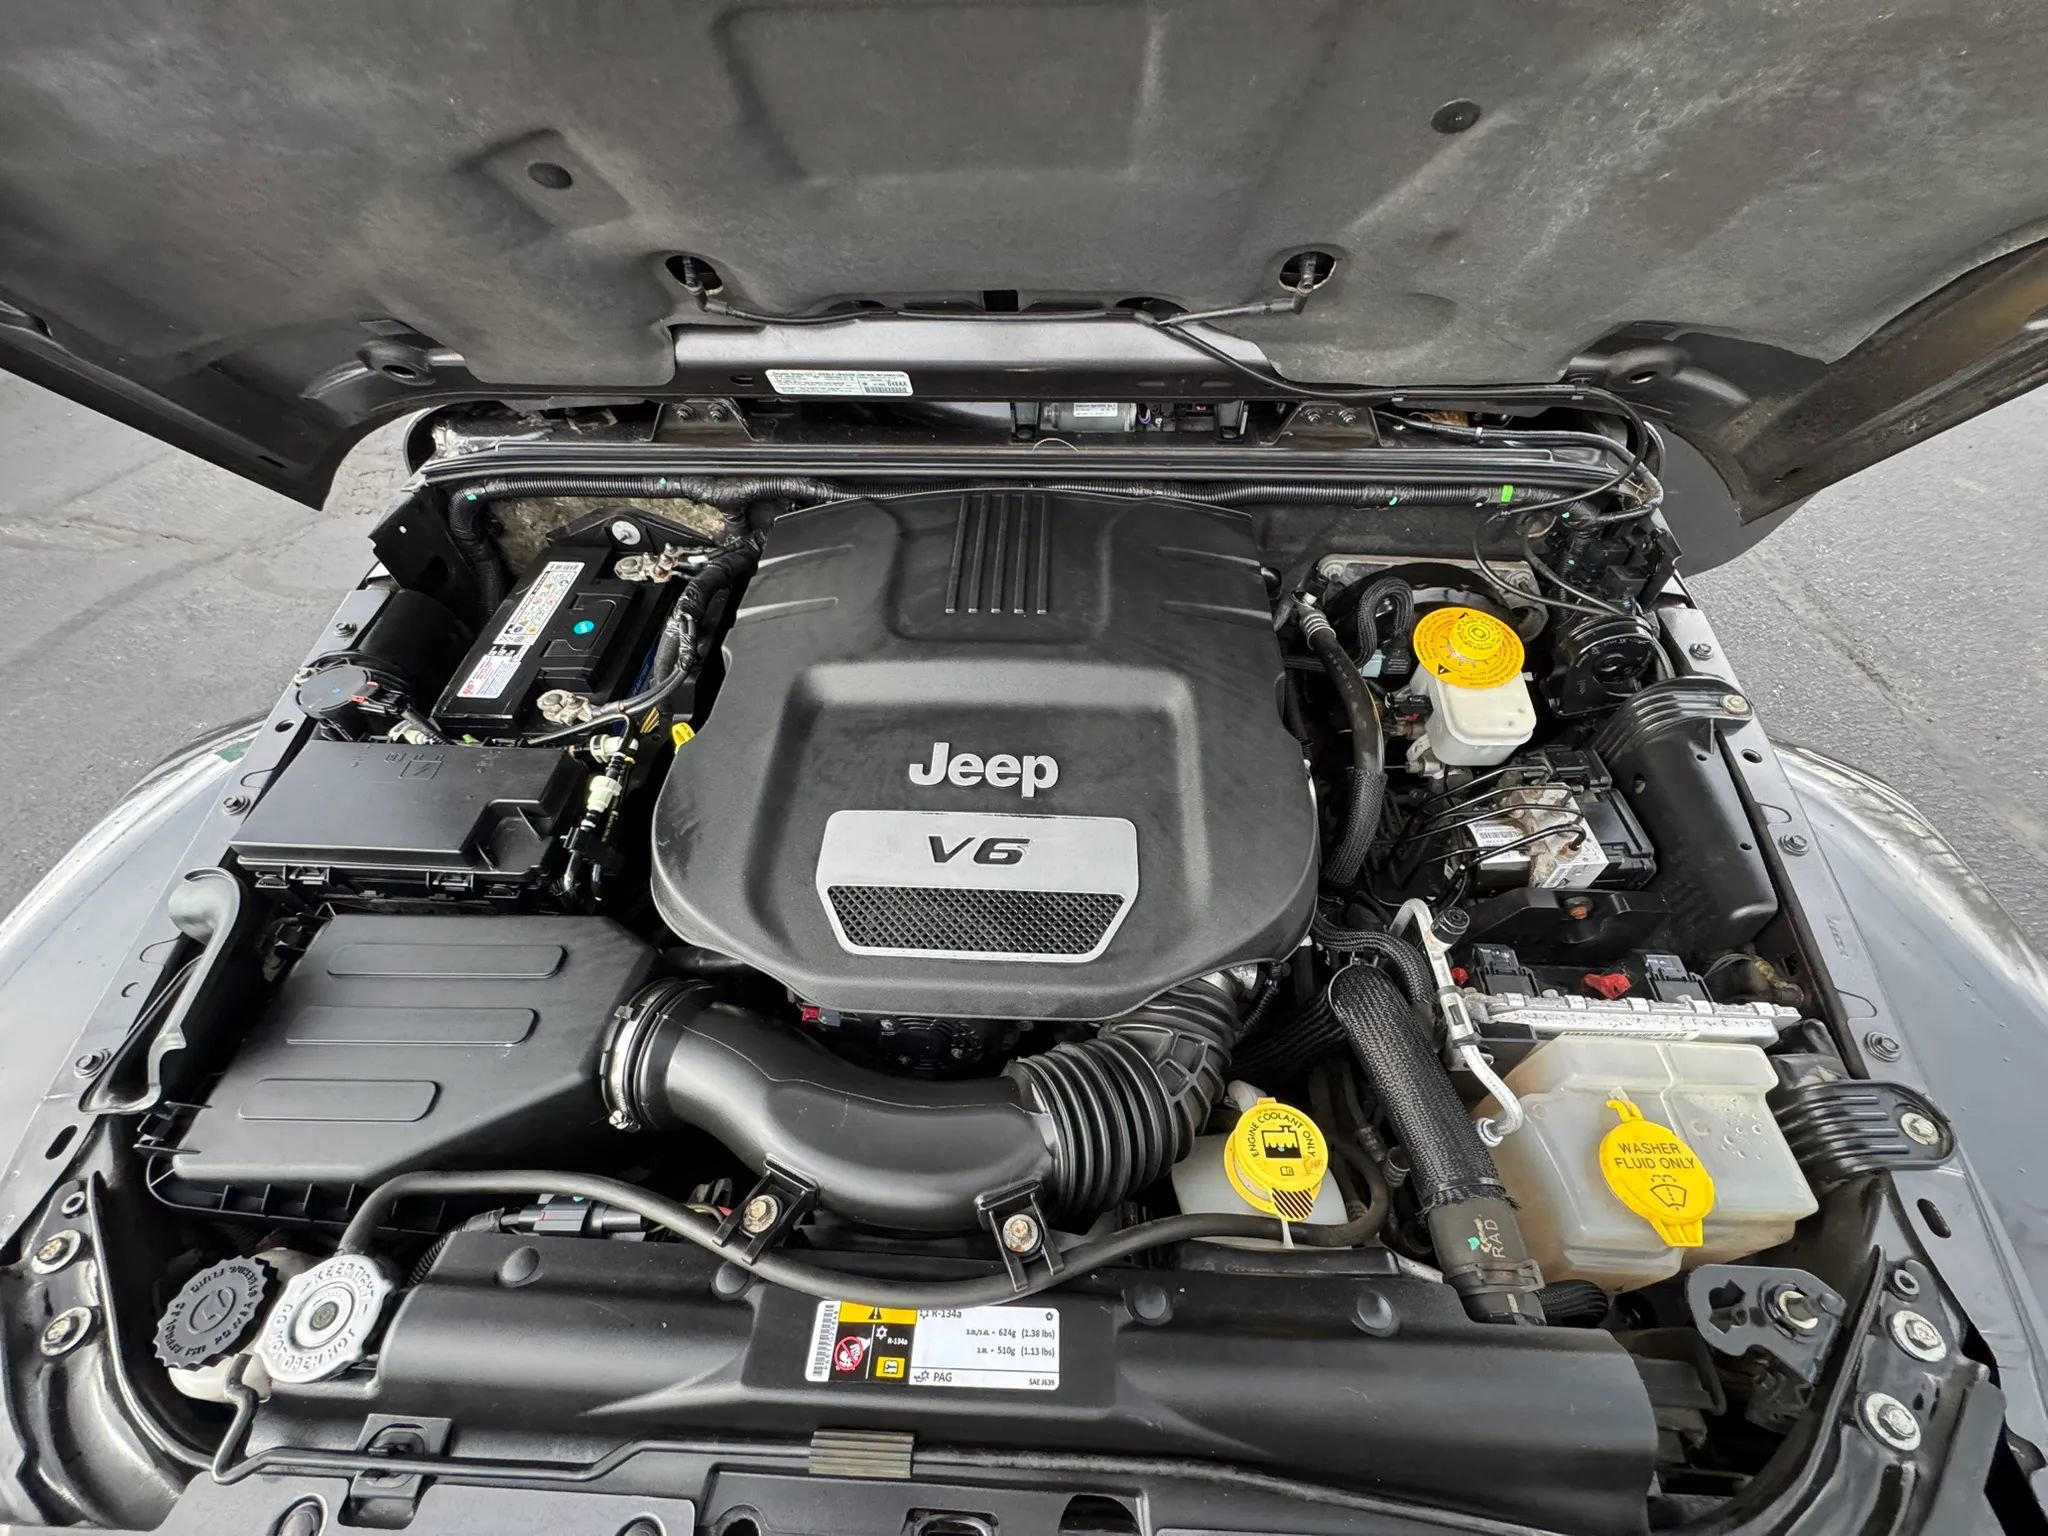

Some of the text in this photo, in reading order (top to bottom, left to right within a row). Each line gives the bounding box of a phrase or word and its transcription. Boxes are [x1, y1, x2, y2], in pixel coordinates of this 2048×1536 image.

[909, 742, 1059, 798] Jeep
[928, 836, 1031, 865] V6
[1247, 1112, 1316, 1157] ENGINE COOLANT ONLY
[1618, 1142, 1681, 1154] WASHER
[1614, 1157, 1696, 1169] FLUID ONLY
[1483, 1219, 1507, 1258] RAD
[190, 1268, 225, 1293] FLUID
[314, 1262, 375, 1299] KEEP TIGHT
[931, 1309, 962, 1319] R-134a
[272, 1303, 355, 1371] DO NOT OPEN HOT
[998, 1328, 1016, 1339] 624g
[1021, 1328, 1040, 1339] (1.38
[1041, 1329, 1055, 1340] lbs)
[997, 1346, 1016, 1357] 510g
[1021, 1346, 1040, 1357] (1.13
[1041, 1347, 1055, 1358] lbs)
[933, 1372, 953, 1383] PAG
[1029, 1378, 1040, 1386] SAE
